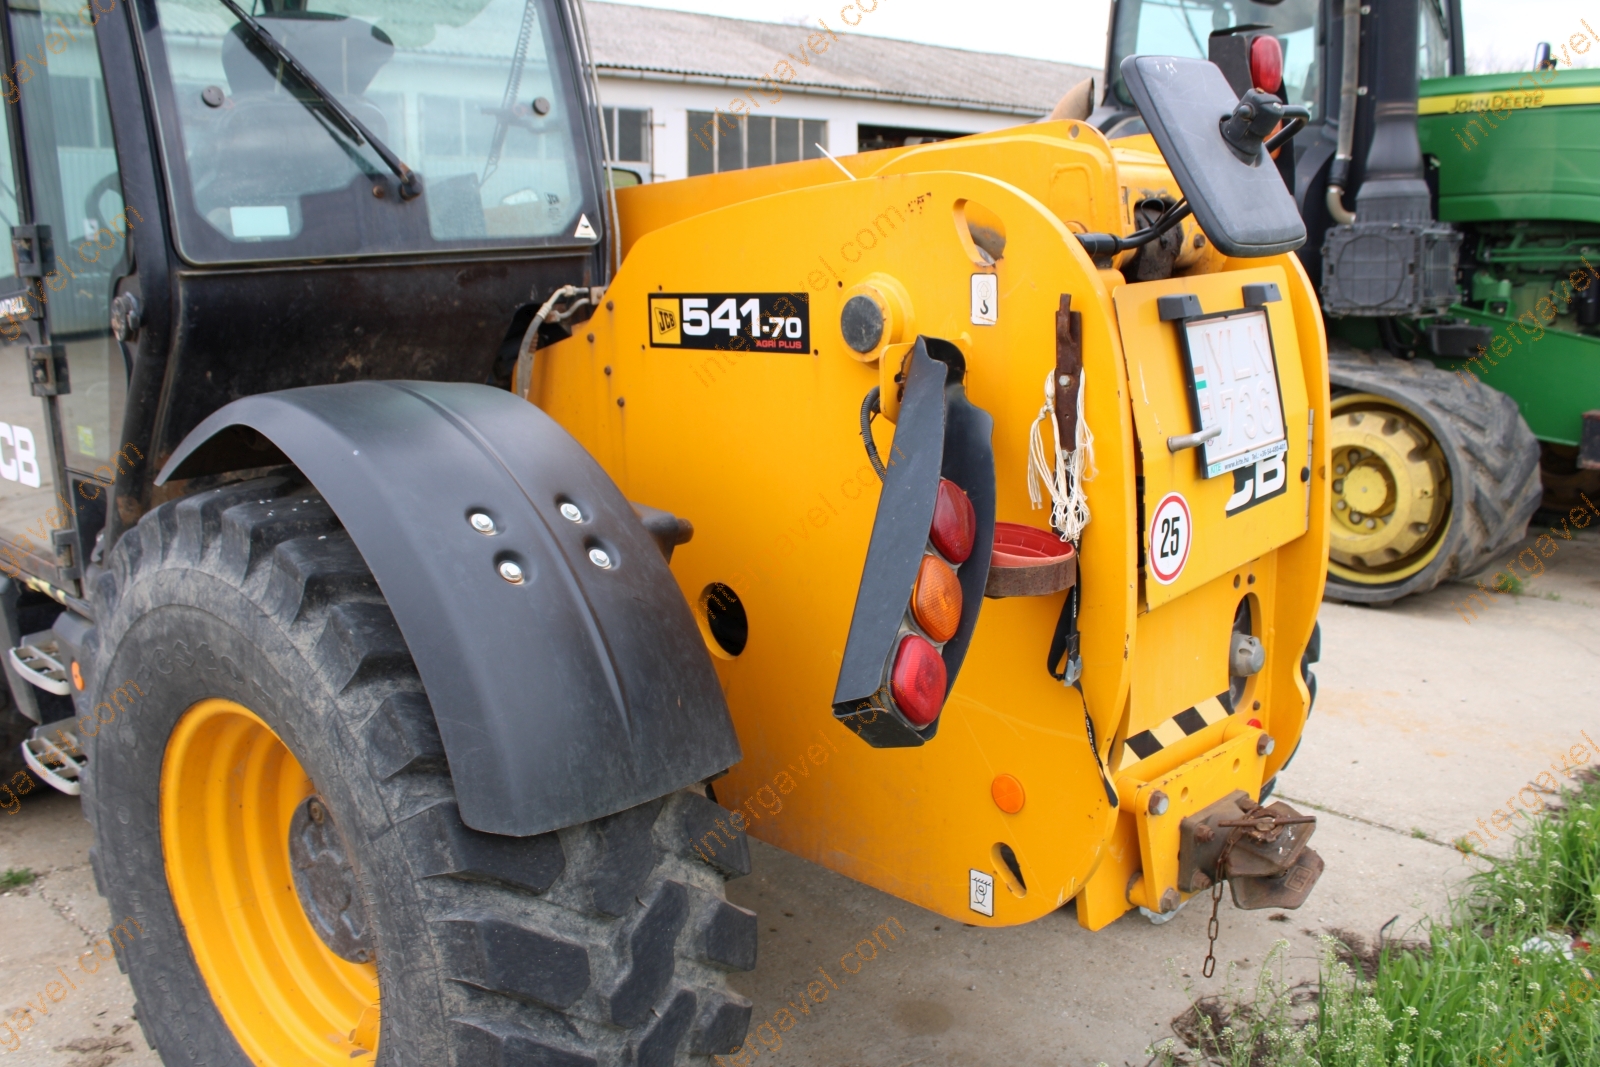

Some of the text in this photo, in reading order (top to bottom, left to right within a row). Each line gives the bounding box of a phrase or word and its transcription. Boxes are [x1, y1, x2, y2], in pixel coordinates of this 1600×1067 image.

[1451, 96, 1543, 113] JOHN DEERE
[658, 311, 675, 331] JCB
[756, 340, 802, 349] AGRI PLUS
[1203, 322, 1271, 386] YLN
[1219, 380, 1274, 446] 736
[1160, 516, 1180, 559] 25
